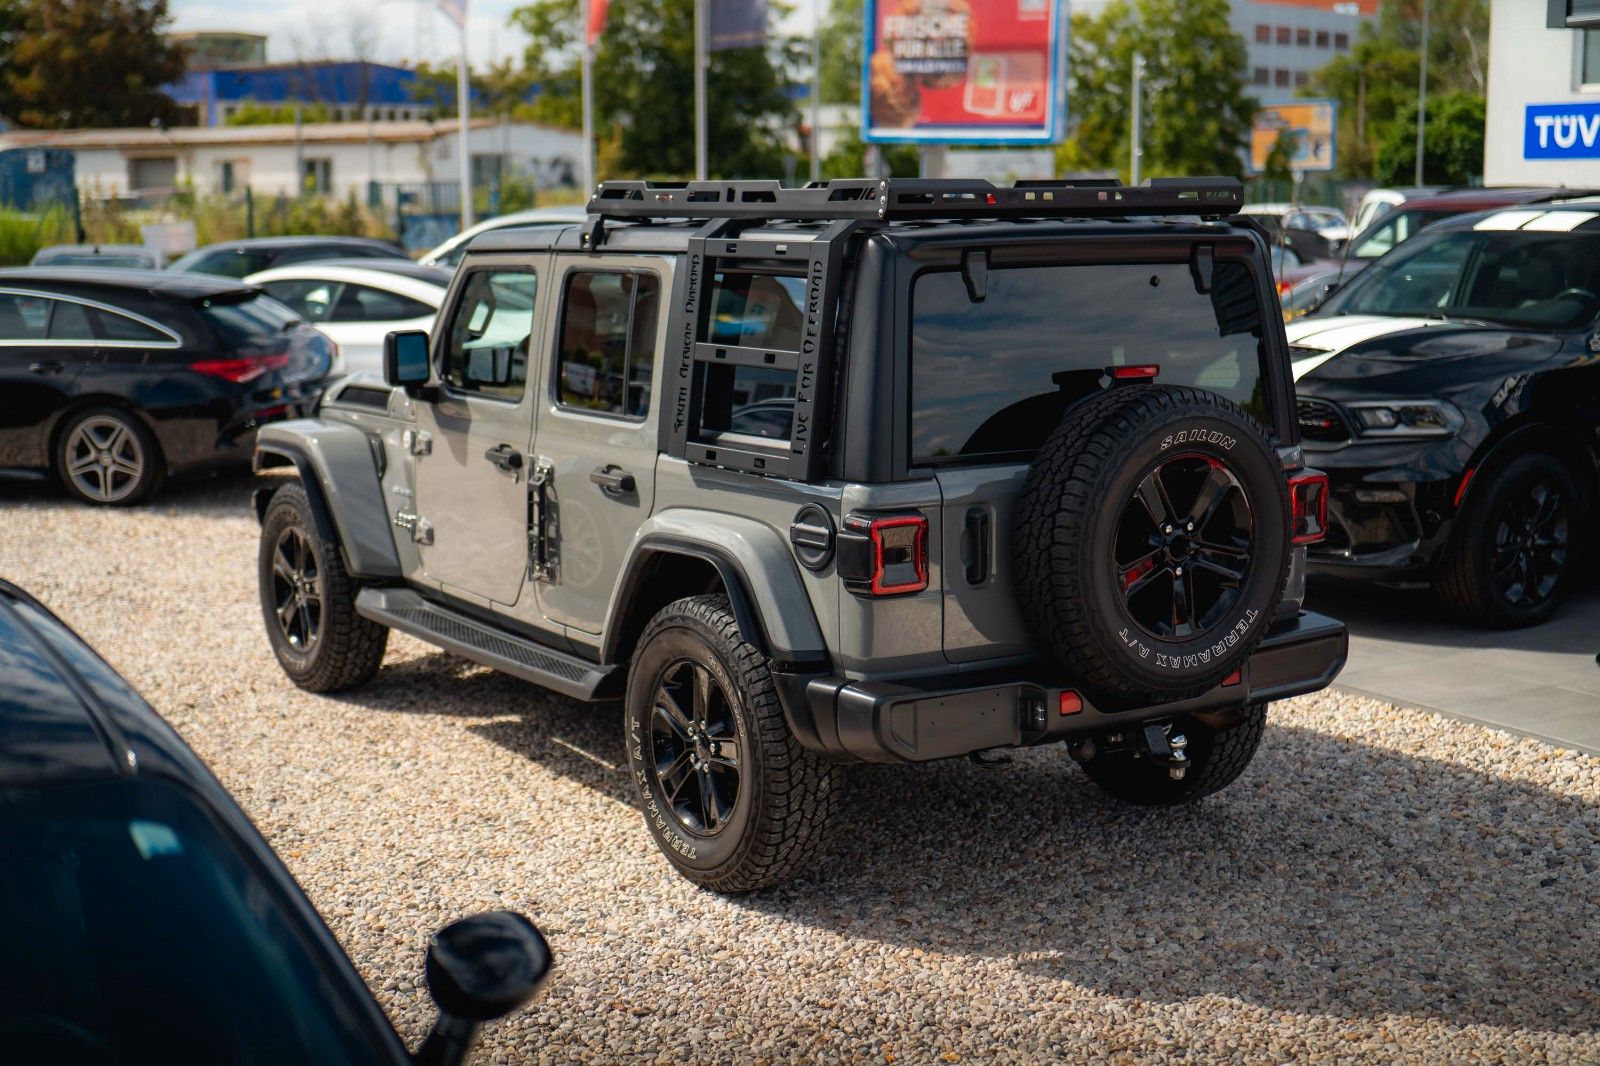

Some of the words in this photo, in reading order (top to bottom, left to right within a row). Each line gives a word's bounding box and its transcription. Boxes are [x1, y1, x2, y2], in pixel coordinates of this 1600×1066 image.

[1534, 115, 1600, 149] TÜV
[1161, 429, 1236, 451] SAILUN
[1119, 628, 1150, 659] A/T
[1156, 609, 1259, 669] TERRAMAX
[630, 716, 643, 761] A/T
[637, 769, 697, 860] TERRAMAX
